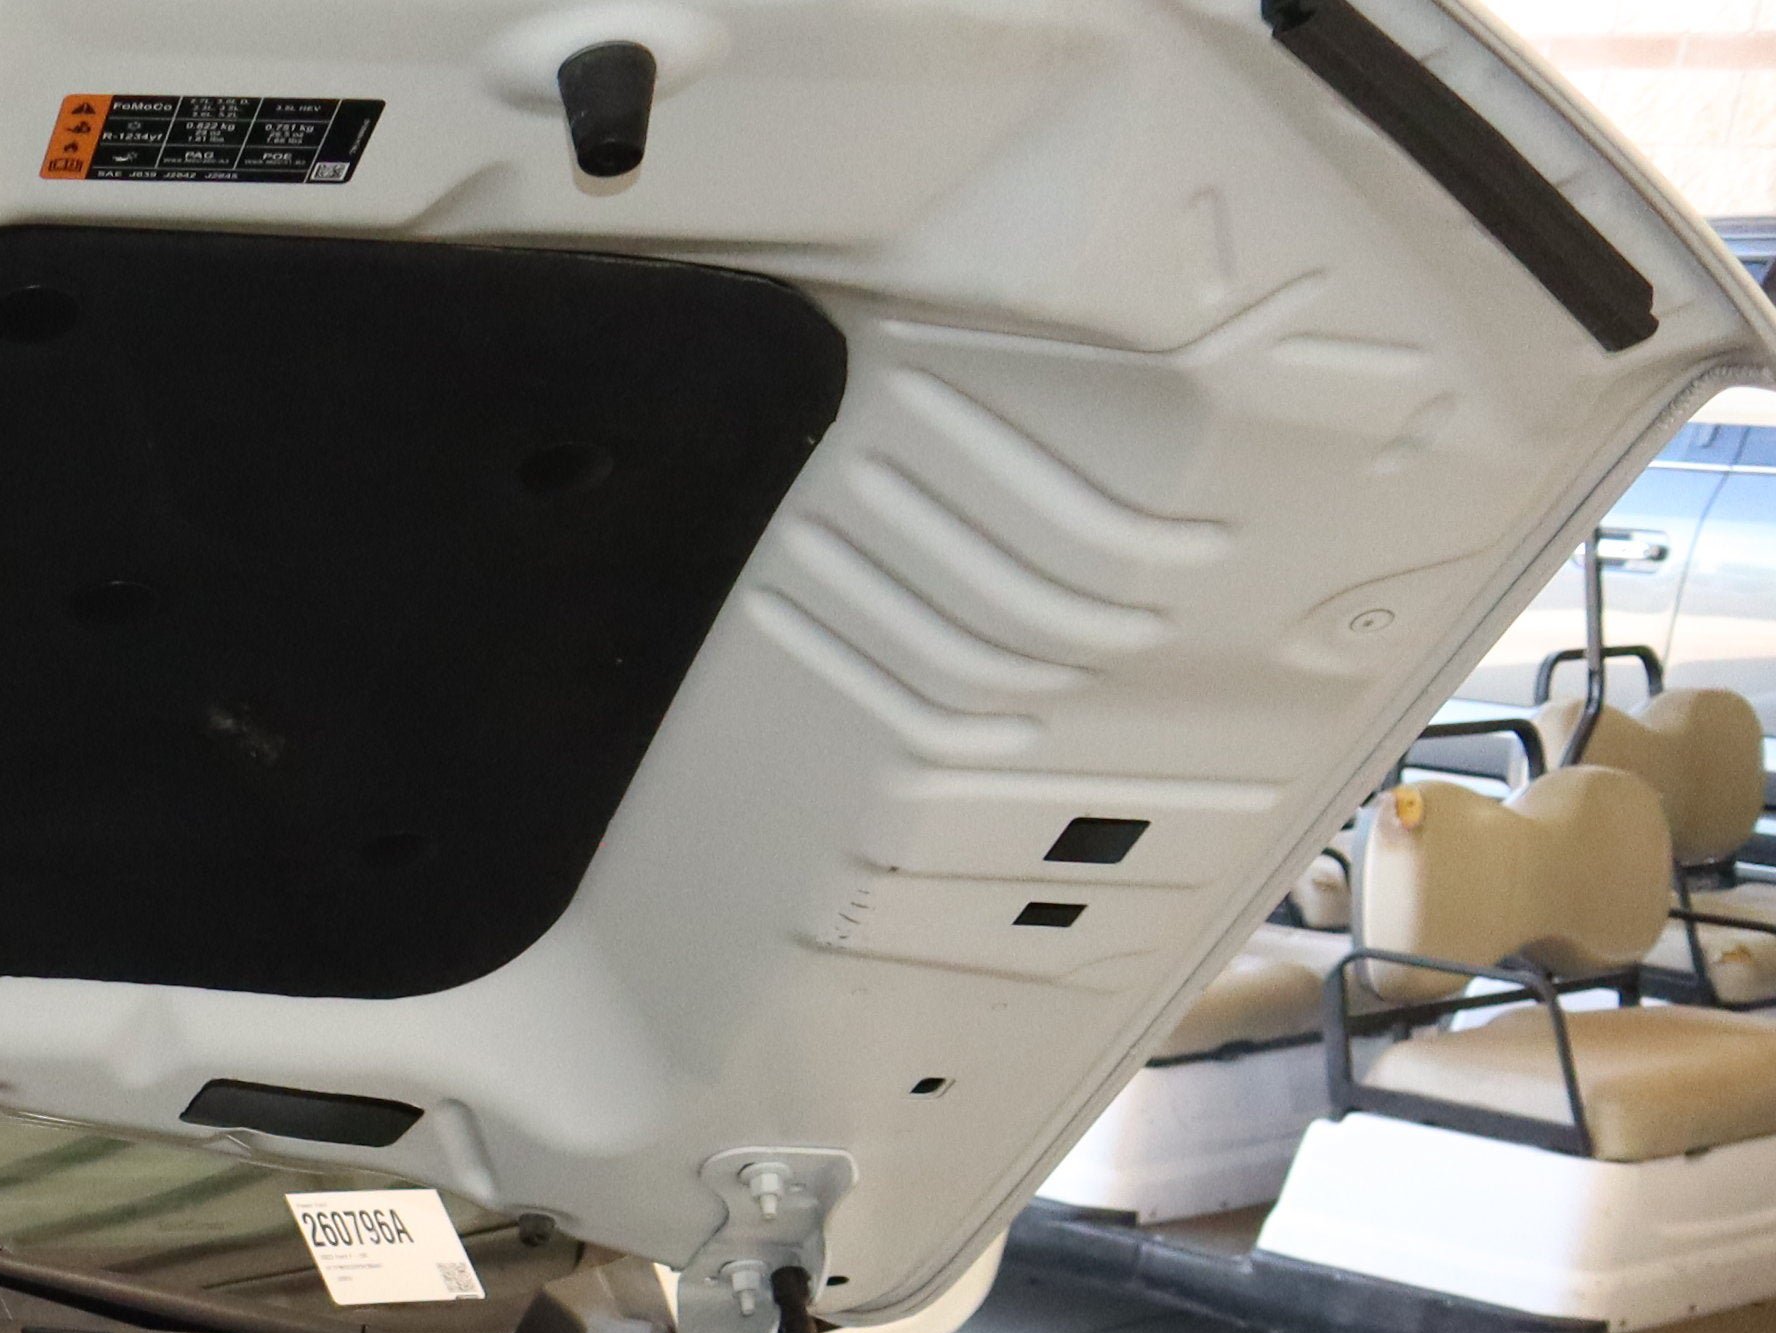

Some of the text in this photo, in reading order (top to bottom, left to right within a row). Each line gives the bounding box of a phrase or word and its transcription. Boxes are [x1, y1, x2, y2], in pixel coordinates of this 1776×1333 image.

[112, 102, 173, 111] FoMoCo
[220, 122, 236, 131] kg
[299, 124, 314, 133] kg
[102, 133, 163, 142] R-1234yf
[185, 151, 214, 159] PAG
[263, 152, 293, 160] POE
[302, 1208, 415, 1248] 260796A
